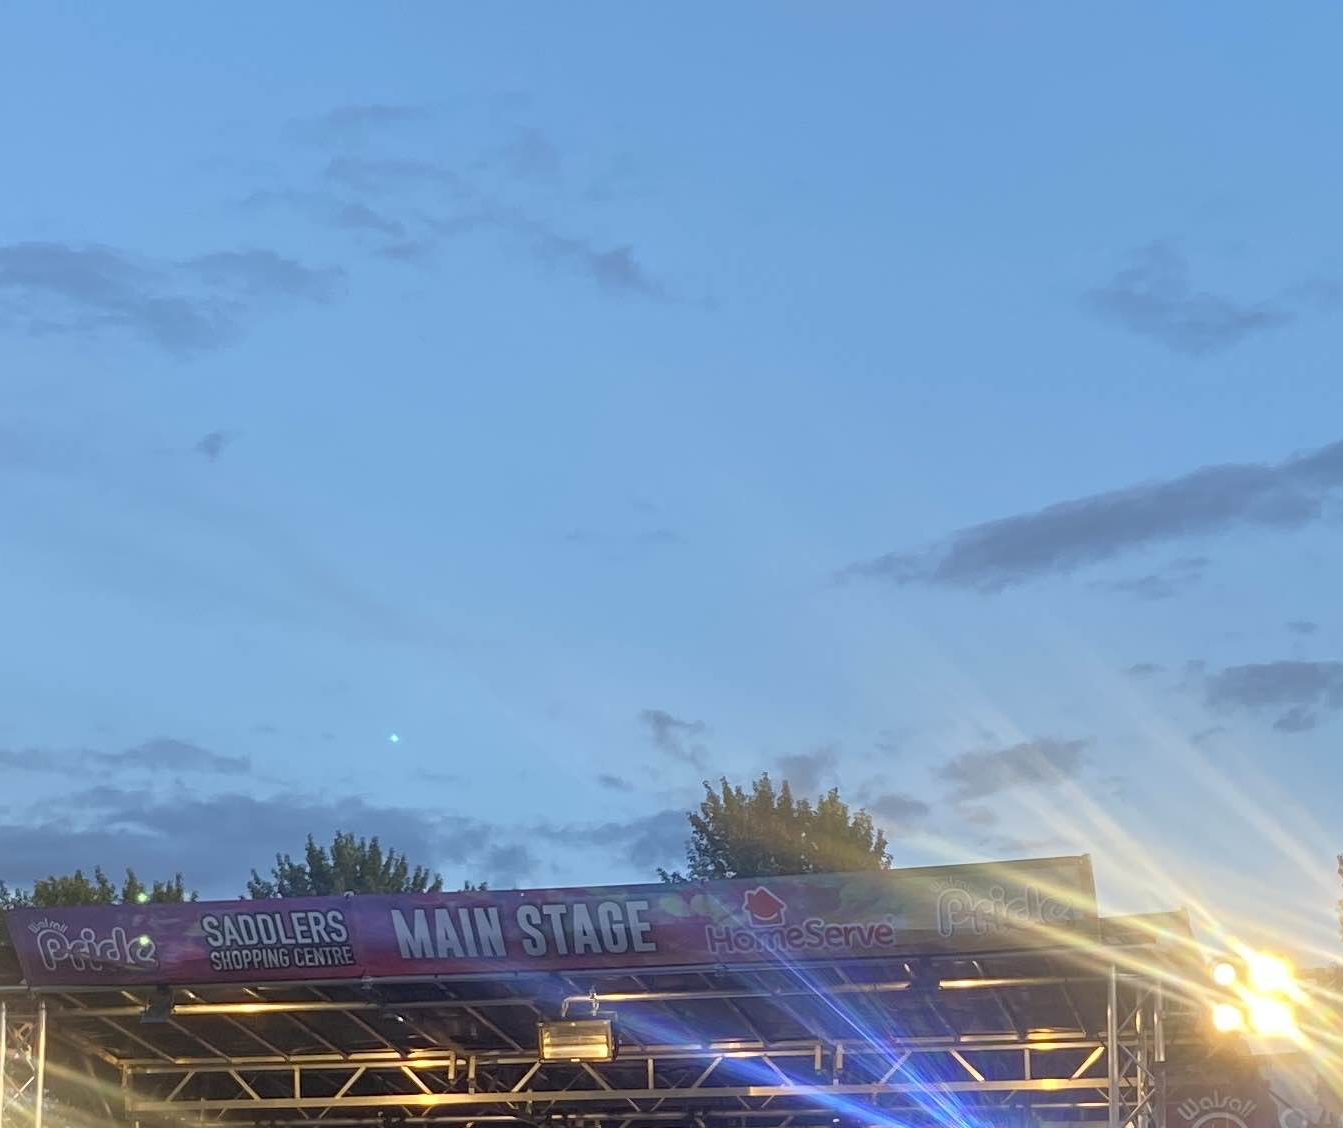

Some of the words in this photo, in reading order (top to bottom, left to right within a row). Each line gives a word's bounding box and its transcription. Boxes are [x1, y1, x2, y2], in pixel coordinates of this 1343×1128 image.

[201, 910, 347, 947] SADDLERS
[390, 907, 506, 959] MAIN
[516, 900, 656, 956] STAGE
[707, 919, 894, 952] HomeServe
[37, 927, 156, 971] Pride
[210, 948, 290, 972] SHOPPING
[293, 945, 355, 967] CENTRE
[1177, 1090, 1256, 1120] Walsall
